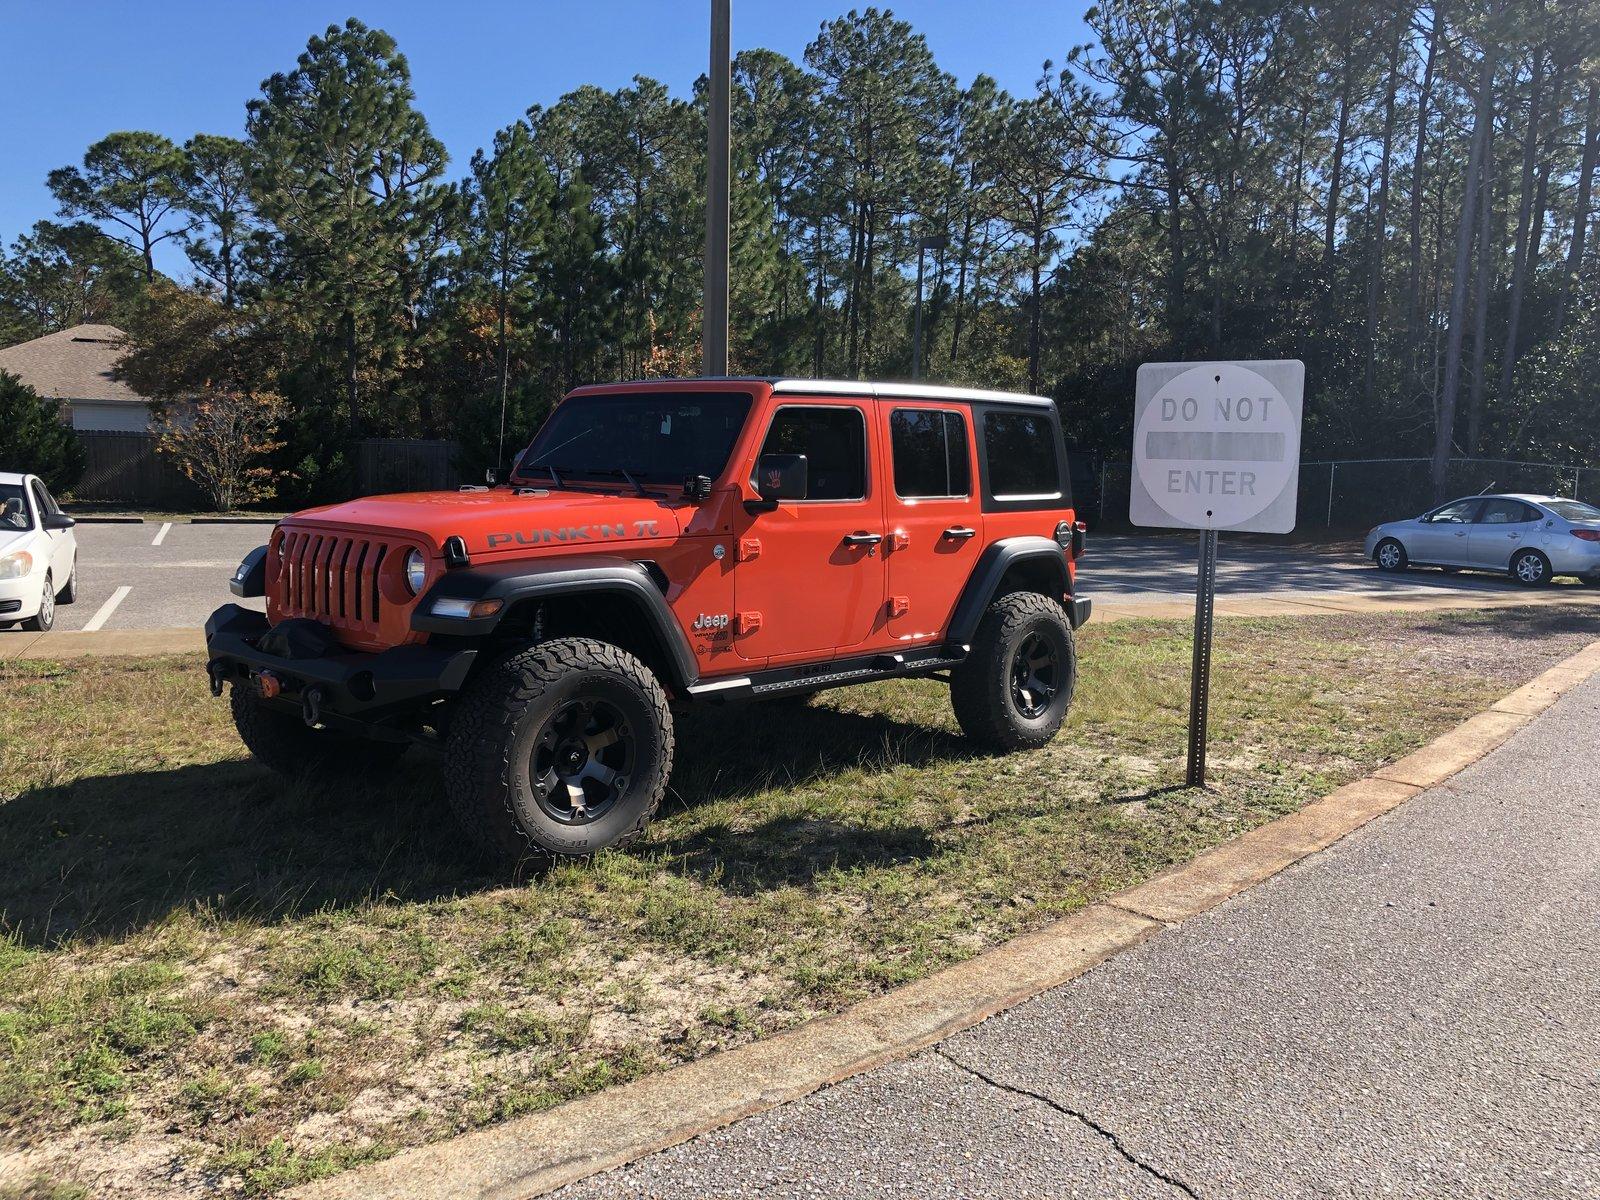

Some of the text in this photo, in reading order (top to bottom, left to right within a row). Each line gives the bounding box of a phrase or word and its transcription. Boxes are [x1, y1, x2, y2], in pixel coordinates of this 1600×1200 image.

[1161, 398, 1273, 422] DO NOT
[1167, 470, 1256, 495] ENTER
[486, 523, 625, 548] PUNK'N
[694, 613, 729, 629] Jeep
